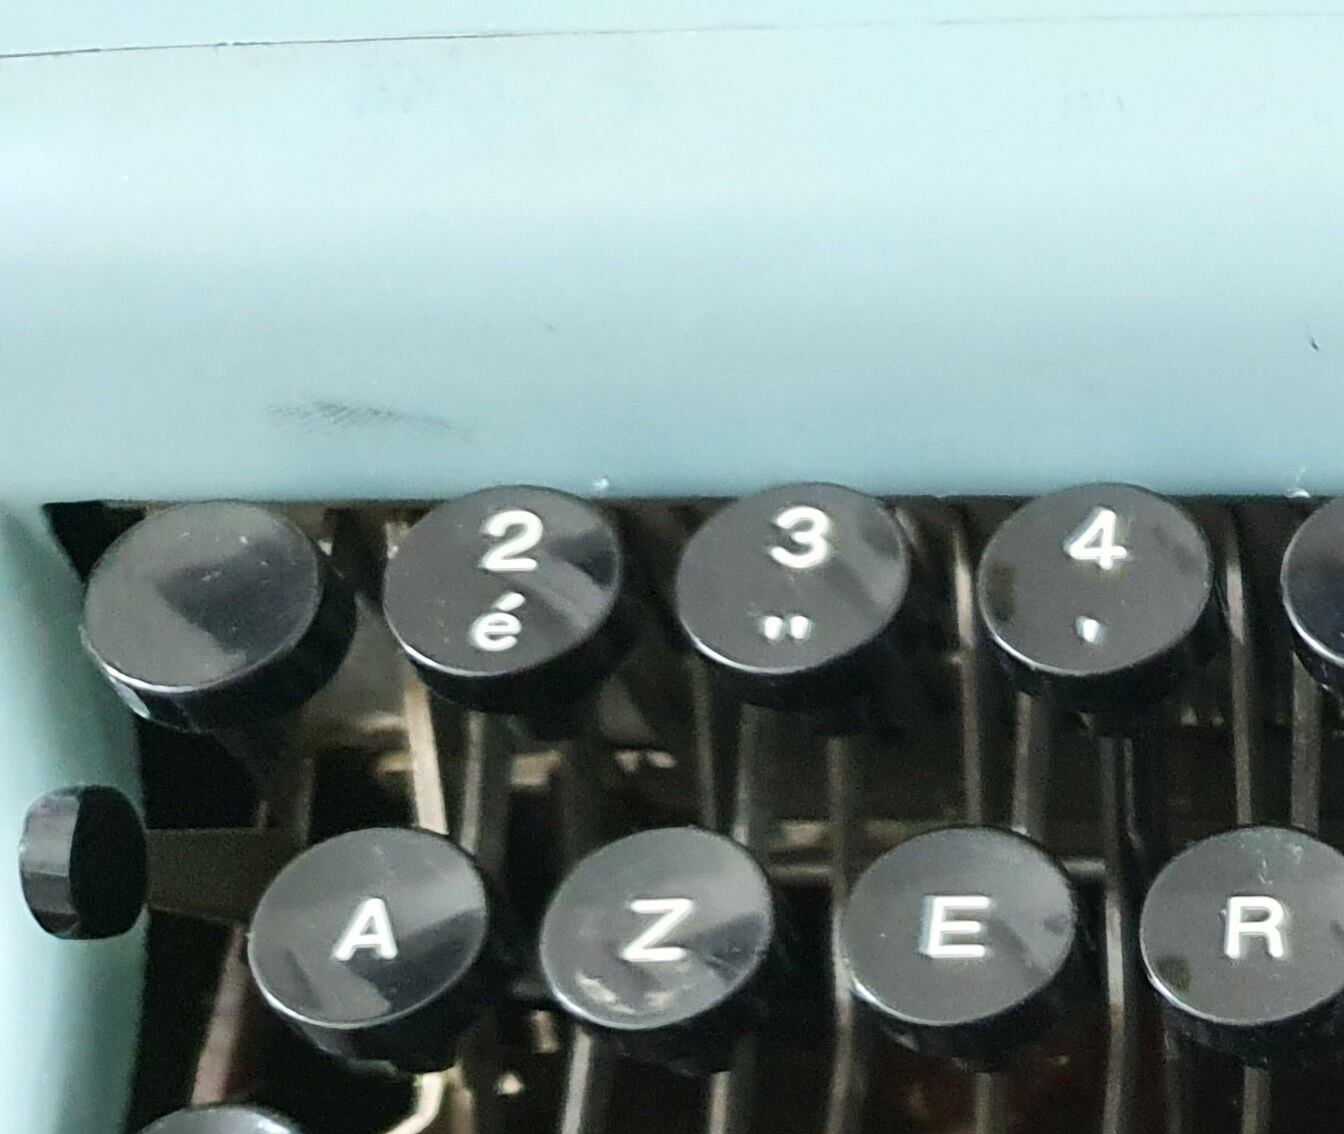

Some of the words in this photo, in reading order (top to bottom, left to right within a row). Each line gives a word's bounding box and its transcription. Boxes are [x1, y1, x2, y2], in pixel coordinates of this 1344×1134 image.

[482, 509, 543, 572] 2
[769, 505, 832, 569] 3
[1066, 508, 1129, 571] 4
[470, 592, 525, 652] é
[332, 897, 397, 961] A
[621, 898, 695, 962] Z
[921, 895, 993, 959] E
[1225, 896, 1287, 959] R
